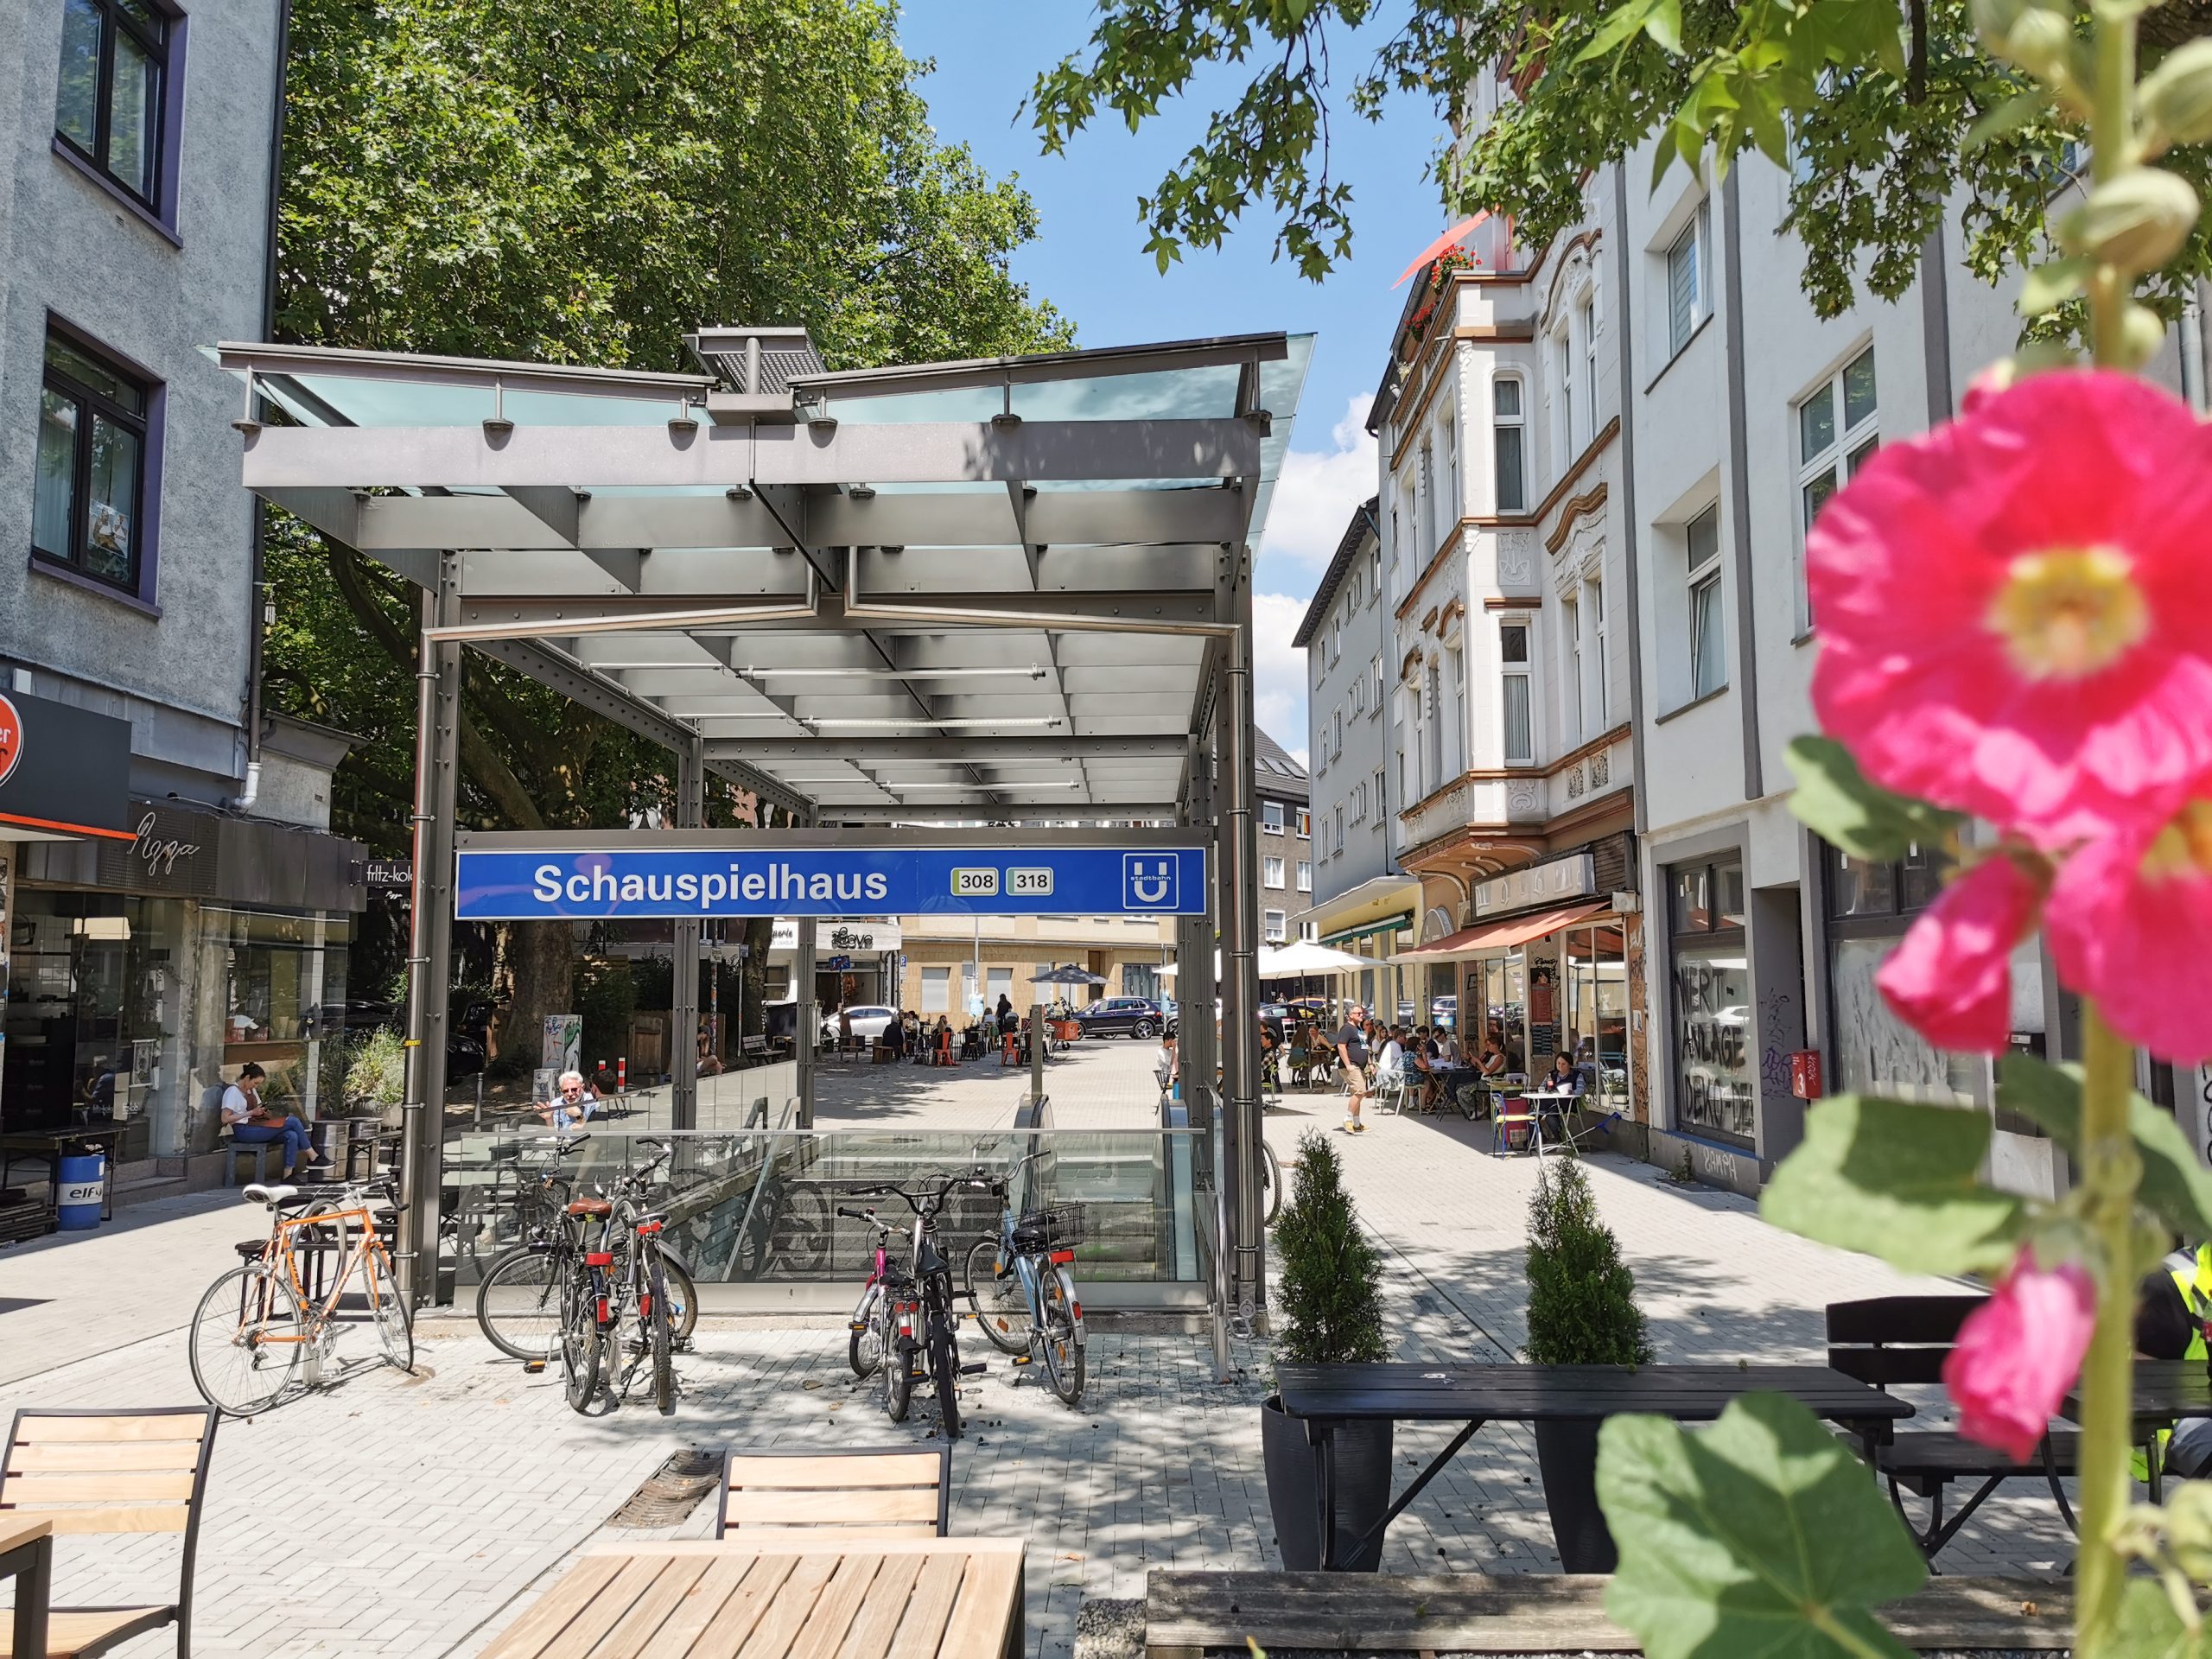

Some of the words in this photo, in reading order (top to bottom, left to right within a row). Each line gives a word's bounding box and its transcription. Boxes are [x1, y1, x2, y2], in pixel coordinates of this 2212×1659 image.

[532, 863, 888, 909] Schauspielhaus
[961, 874, 994, 888] 308
[1016, 874, 1048, 888] 318
[1797, 1072, 1804, 1094] 3
[69, 1187, 95, 1198] elf
